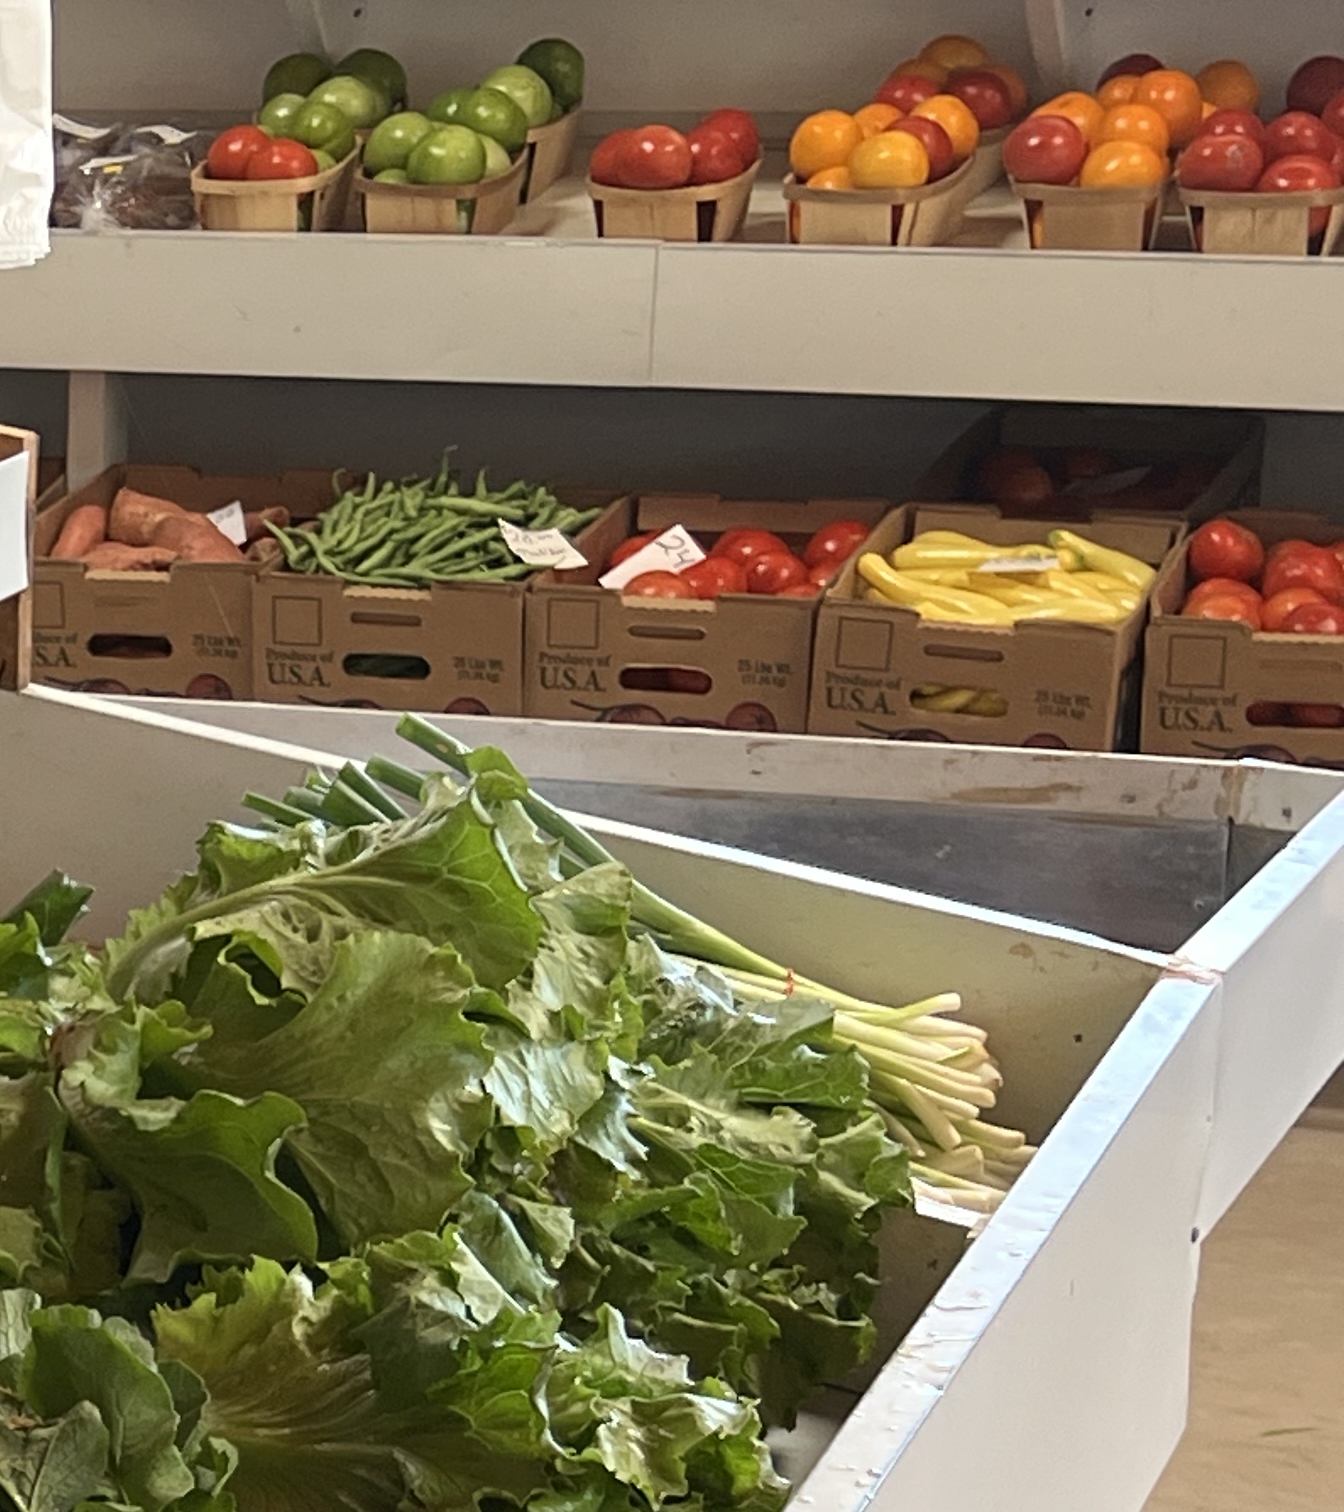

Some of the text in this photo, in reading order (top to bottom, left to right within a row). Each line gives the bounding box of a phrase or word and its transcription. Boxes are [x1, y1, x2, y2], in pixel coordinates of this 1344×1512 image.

[267, 661, 332, 688] U.S.A.
[539, 666, 608, 693] U.S.A.
[825, 686, 897, 716] U.S.A.
[1159, 705, 1233, 733] U.S.A.
